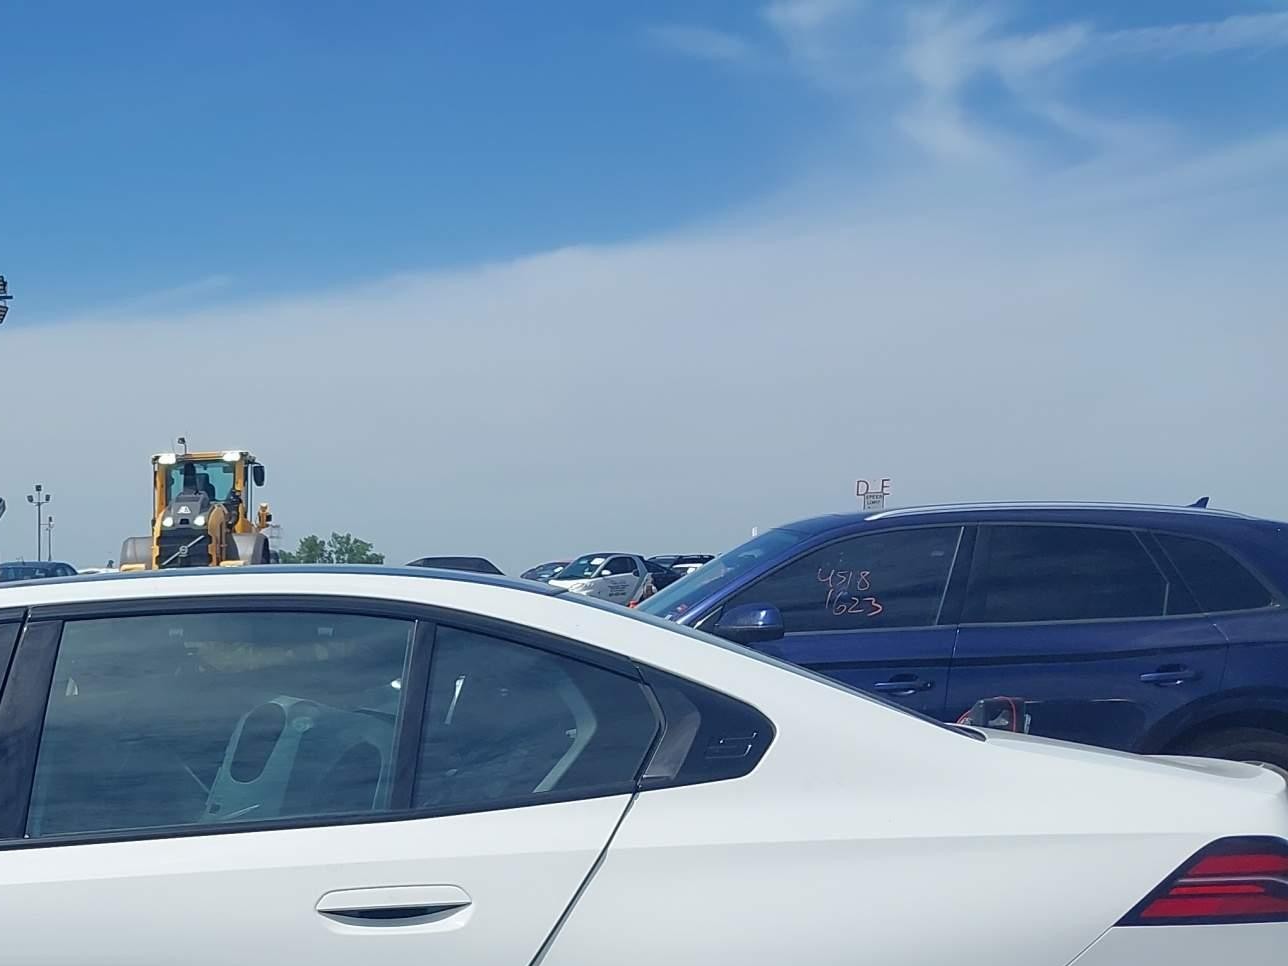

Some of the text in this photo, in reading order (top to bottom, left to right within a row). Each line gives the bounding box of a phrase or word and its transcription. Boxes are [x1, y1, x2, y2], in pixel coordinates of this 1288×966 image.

[856, 480, 869, 496] D
[881, 479, 890, 495] E
[817, 568, 870, 590] 4518
[825, 589, 882, 616] 1623
